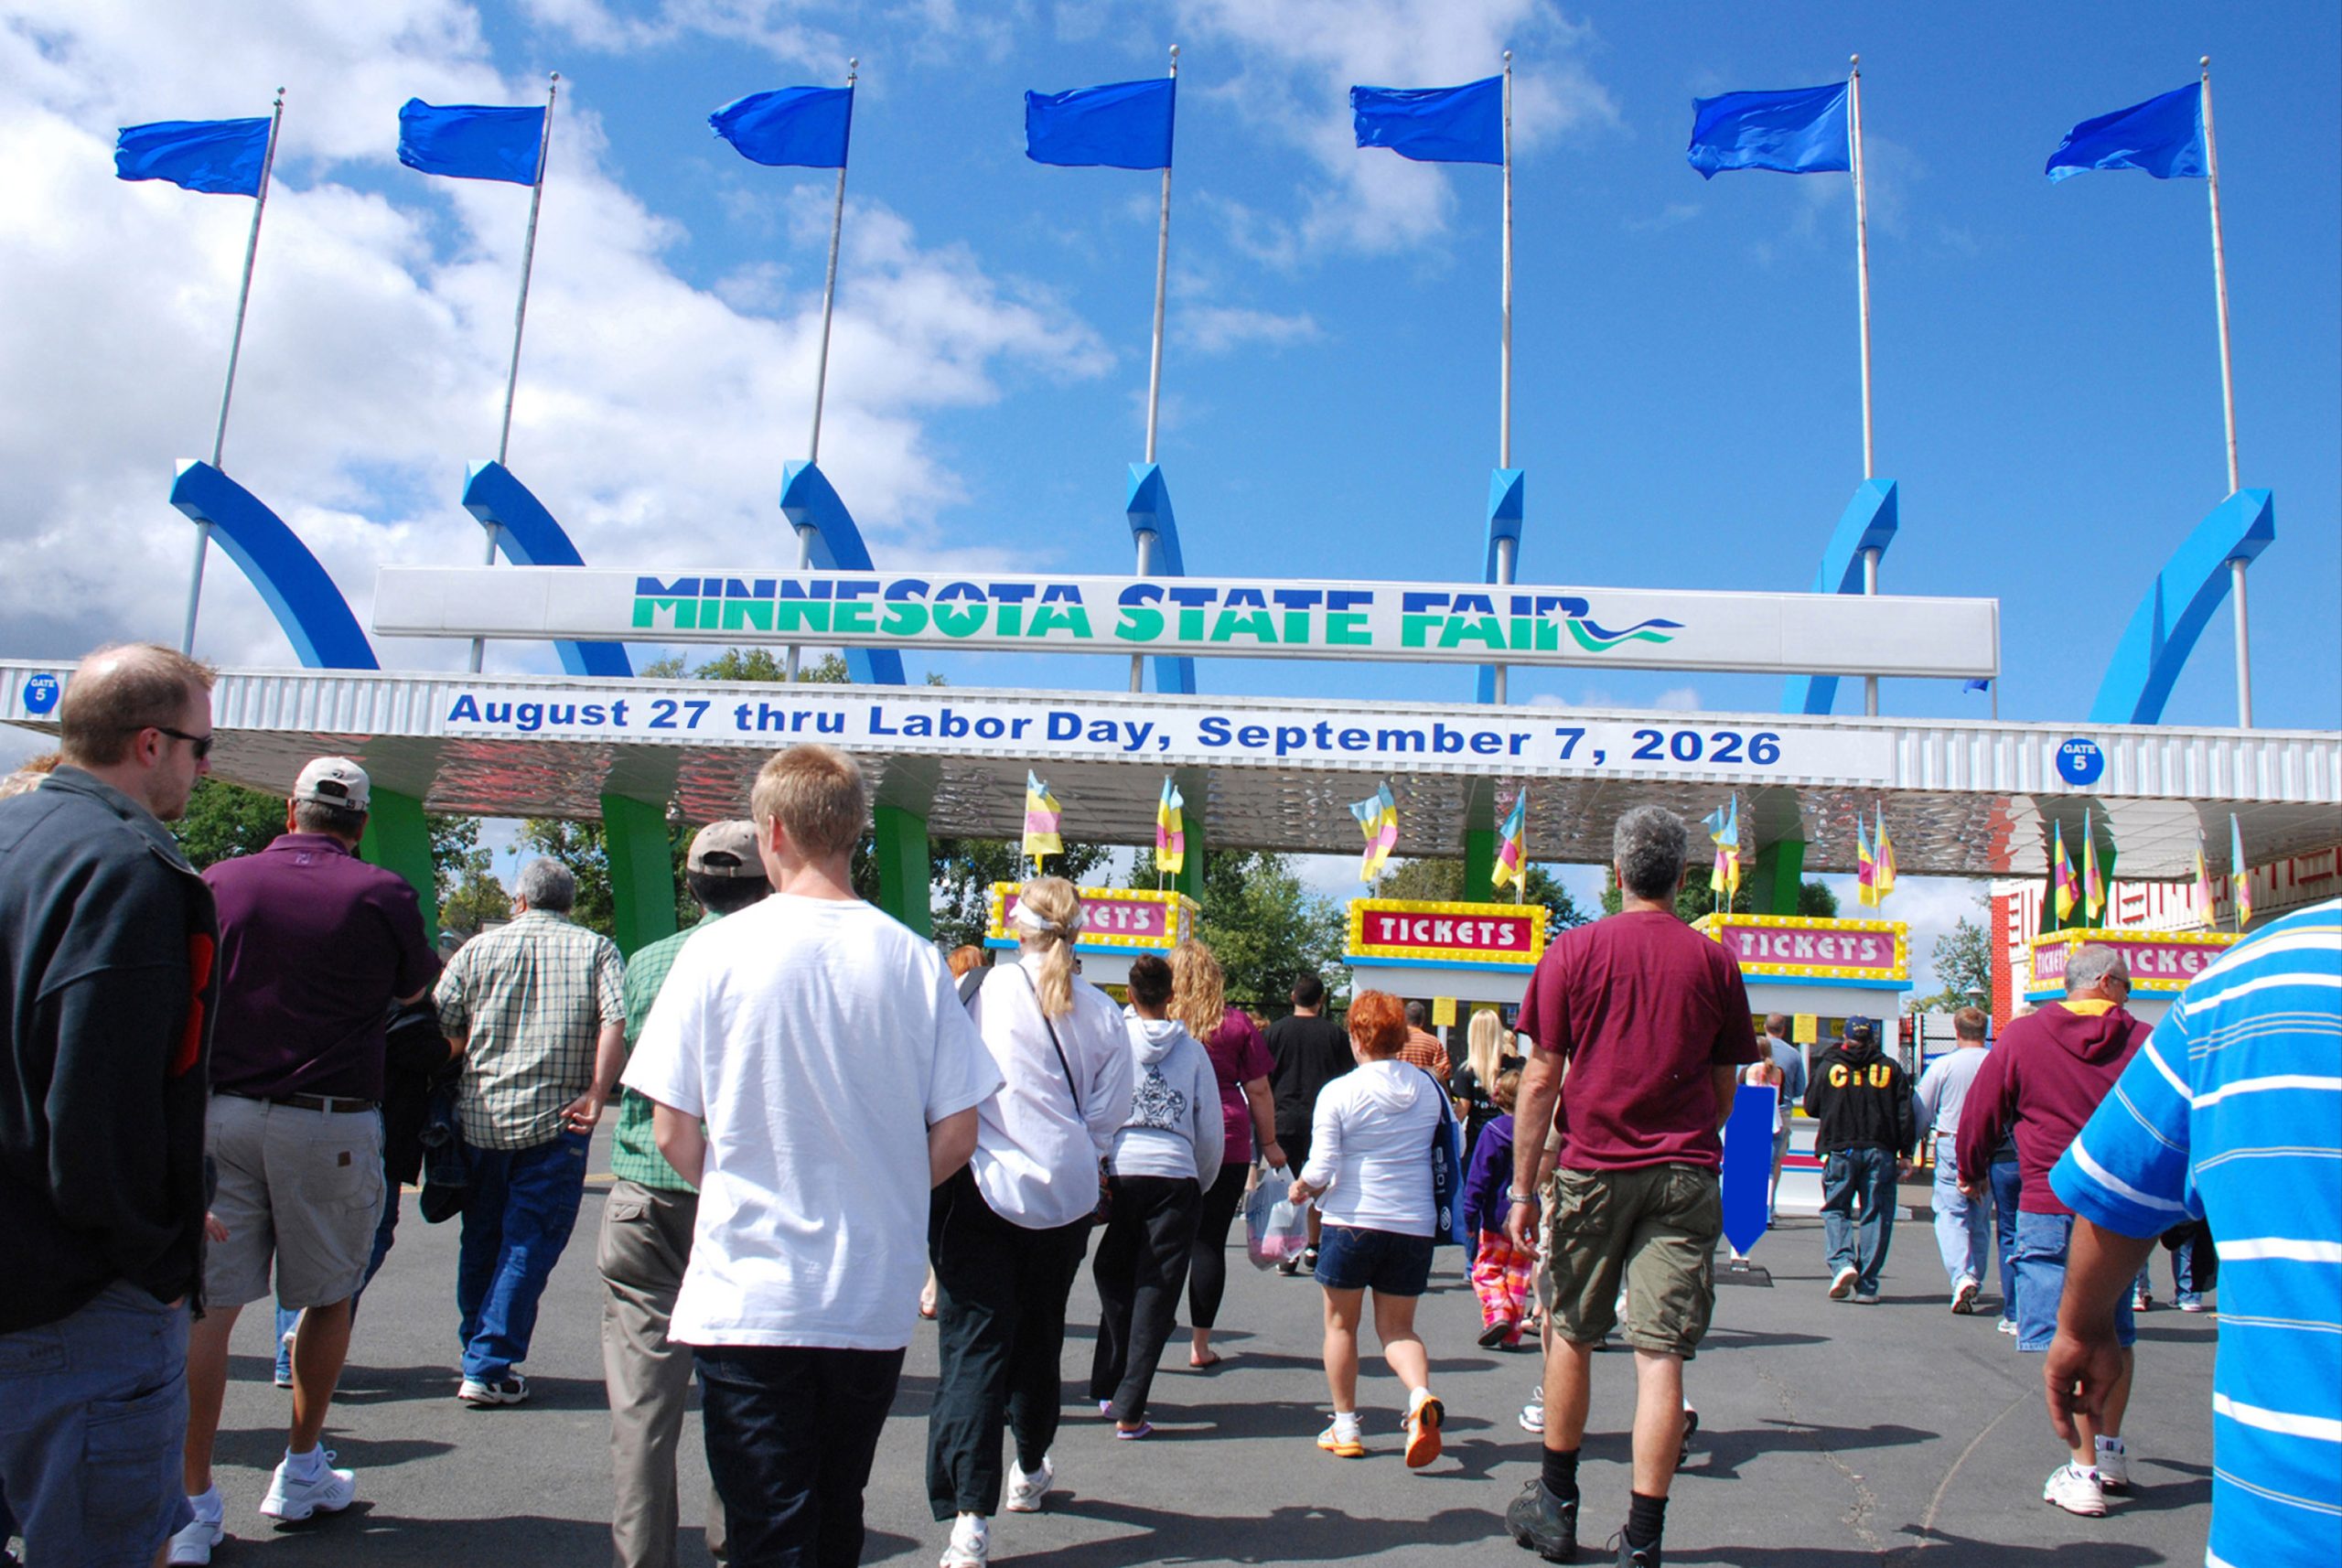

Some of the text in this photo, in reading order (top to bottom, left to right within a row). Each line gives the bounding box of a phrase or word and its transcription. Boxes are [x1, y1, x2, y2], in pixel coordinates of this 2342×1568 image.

[632, 577, 1599, 652] MINNESOTA STATE FAIR
[31, 679, 55, 687] GATE
[36, 688, 46, 701] 5
[448, 694, 1780, 766] August 27 thru Labor Day, September 7, 2026
[2064, 744, 2096, 754] GATE
[2073, 755, 2087, 770] 5
[1380, 918, 1515, 945] TICKETS
[1739, 932, 1877, 961] TICKETS
